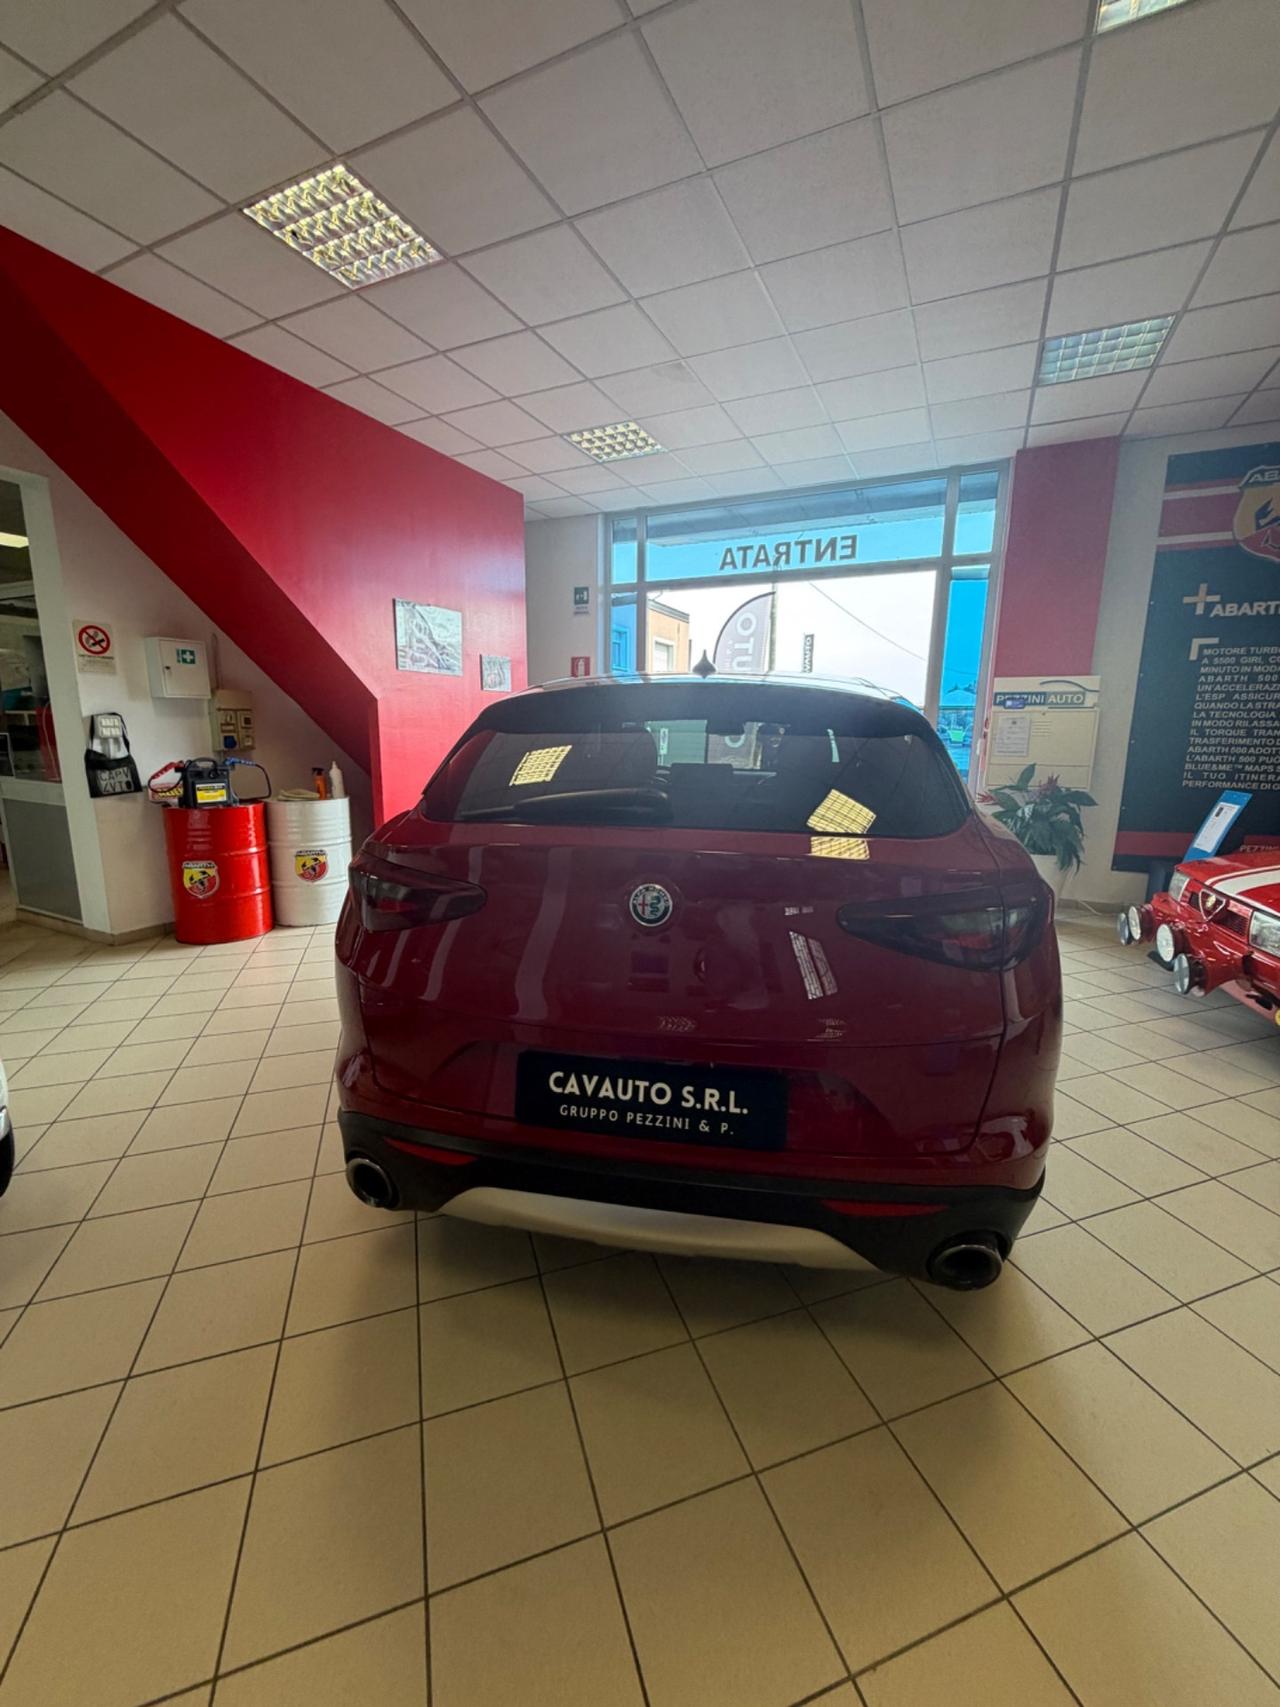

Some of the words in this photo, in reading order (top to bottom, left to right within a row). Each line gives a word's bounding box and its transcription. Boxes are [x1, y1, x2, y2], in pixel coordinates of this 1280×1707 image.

[1249, 470, 1280, 483] AB
[1210, 600, 1280, 618] ABART
[1203, 647, 1247, 655] MOTORE
[1199, 675, 1249, 683] ABARTH
[1048, 694, 1084, 704] AUTO
[1194, 702, 1239, 710] QUANDO
[1188, 737, 1275, 745] TRASFERIMENTO
[1243, 764, 1274, 772] MAPS
[1182, 780, 1258, 789] PERFORMANCE
[548, 1071, 672, 1105] CAVAUTO
[681, 1085, 749, 1115] S.R.L.
[559, 1104, 619, 1122] GRUPPO
[626, 1111, 690, 1130] PEZZINI
[698, 1119, 710, 1132] &
[720, 1123, 734, 1135] P.
